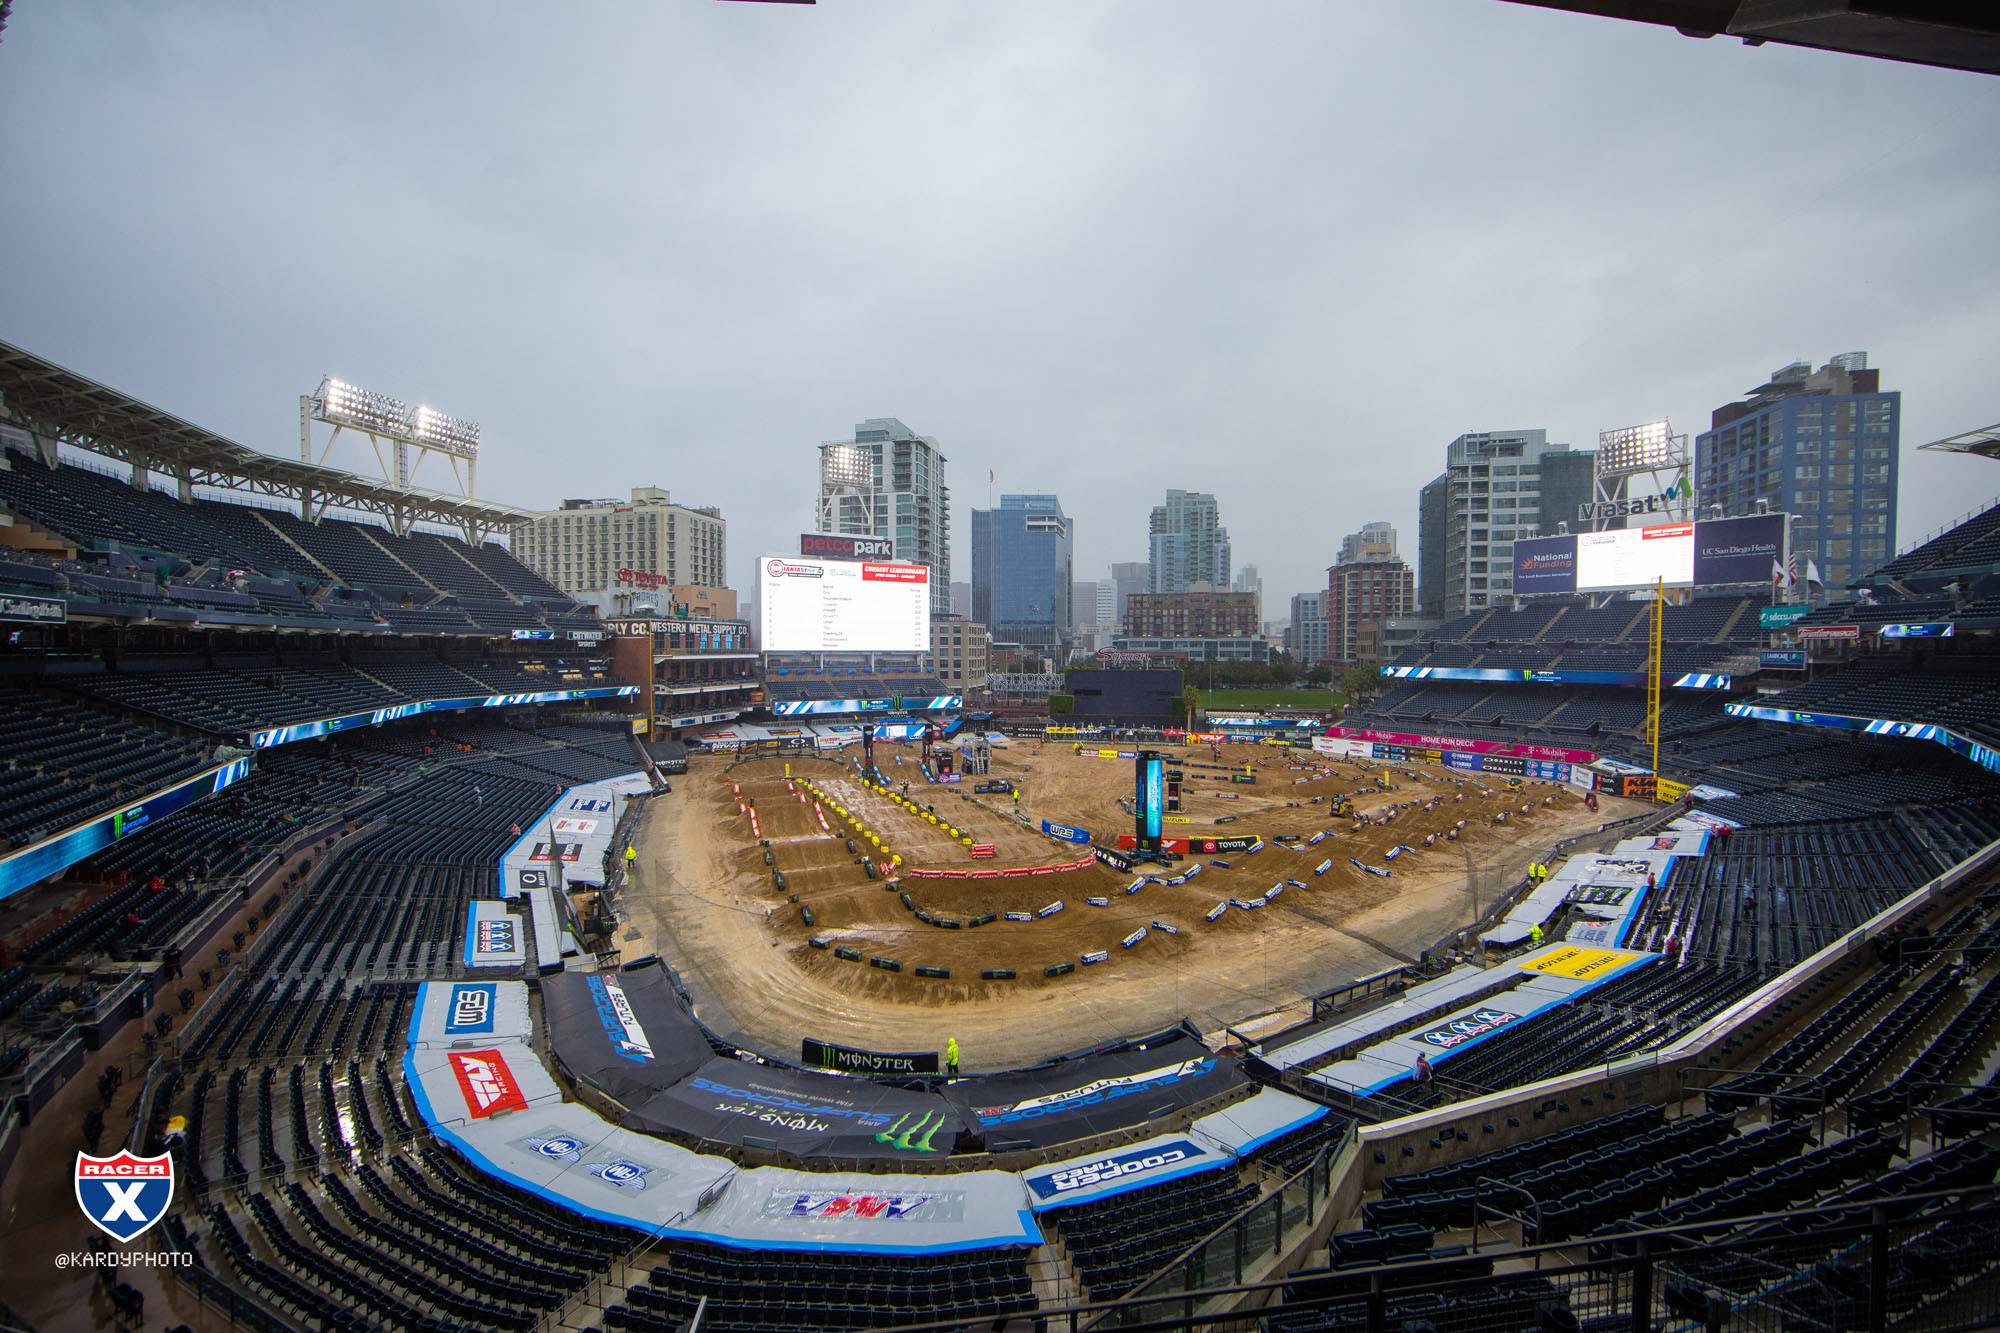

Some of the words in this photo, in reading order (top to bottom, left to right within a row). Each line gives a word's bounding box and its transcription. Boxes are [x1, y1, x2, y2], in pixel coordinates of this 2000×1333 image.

[1581, 495, 1656, 520] Viasat
[1533, 551, 1572, 562] National
[1702, 547, 1714, 556] UC
[1714, 546, 1729, 555] San
[1729, 545, 1751, 555] Diego
[1751, 543, 1776, 552] Health
[1533, 560, 1572, 569] Funding
[634, 571, 668, 585] TOYOTA
[631, 622, 650, 635] CO.
[651, 621, 686, 633] WESTERN
[689, 623, 711, 634] METAL
[713, 624, 736, 635] SUPPLY
[738, 625, 749, 635] CO.
[1421, 735, 1441, 745] HOME
[1441, 737, 1455, 746] RUN
[1456, 739, 1475, 748] DECK
[1050, 825, 1074, 839] WPS
[1218, 840, 1247, 849] TOYOTA
[1536, 950, 1577, 971] DUNLOP
[1573, 955, 1615, 977] DUNLOP
[453, 989, 489, 1026] WPS
[585, 975, 629, 1043] SUPERCROSS
[611, 993, 637, 1026] FUTURES
[838, 1051, 915, 1072] MONSTER
[459, 1055, 502, 1110] FLY
[488, 1061, 509, 1095] RACING
[687, 1077, 897, 1124] SUPERCROSS
[978, 1074, 1182, 1128] SUPERCROSS
[1037, 1077, 1135, 1106] FUTURES
[714, 1102, 829, 1133] MONSTER
[1051, 1159, 1118, 1182] TIRES
[1052, 1149, 1187, 1192] COOPER
